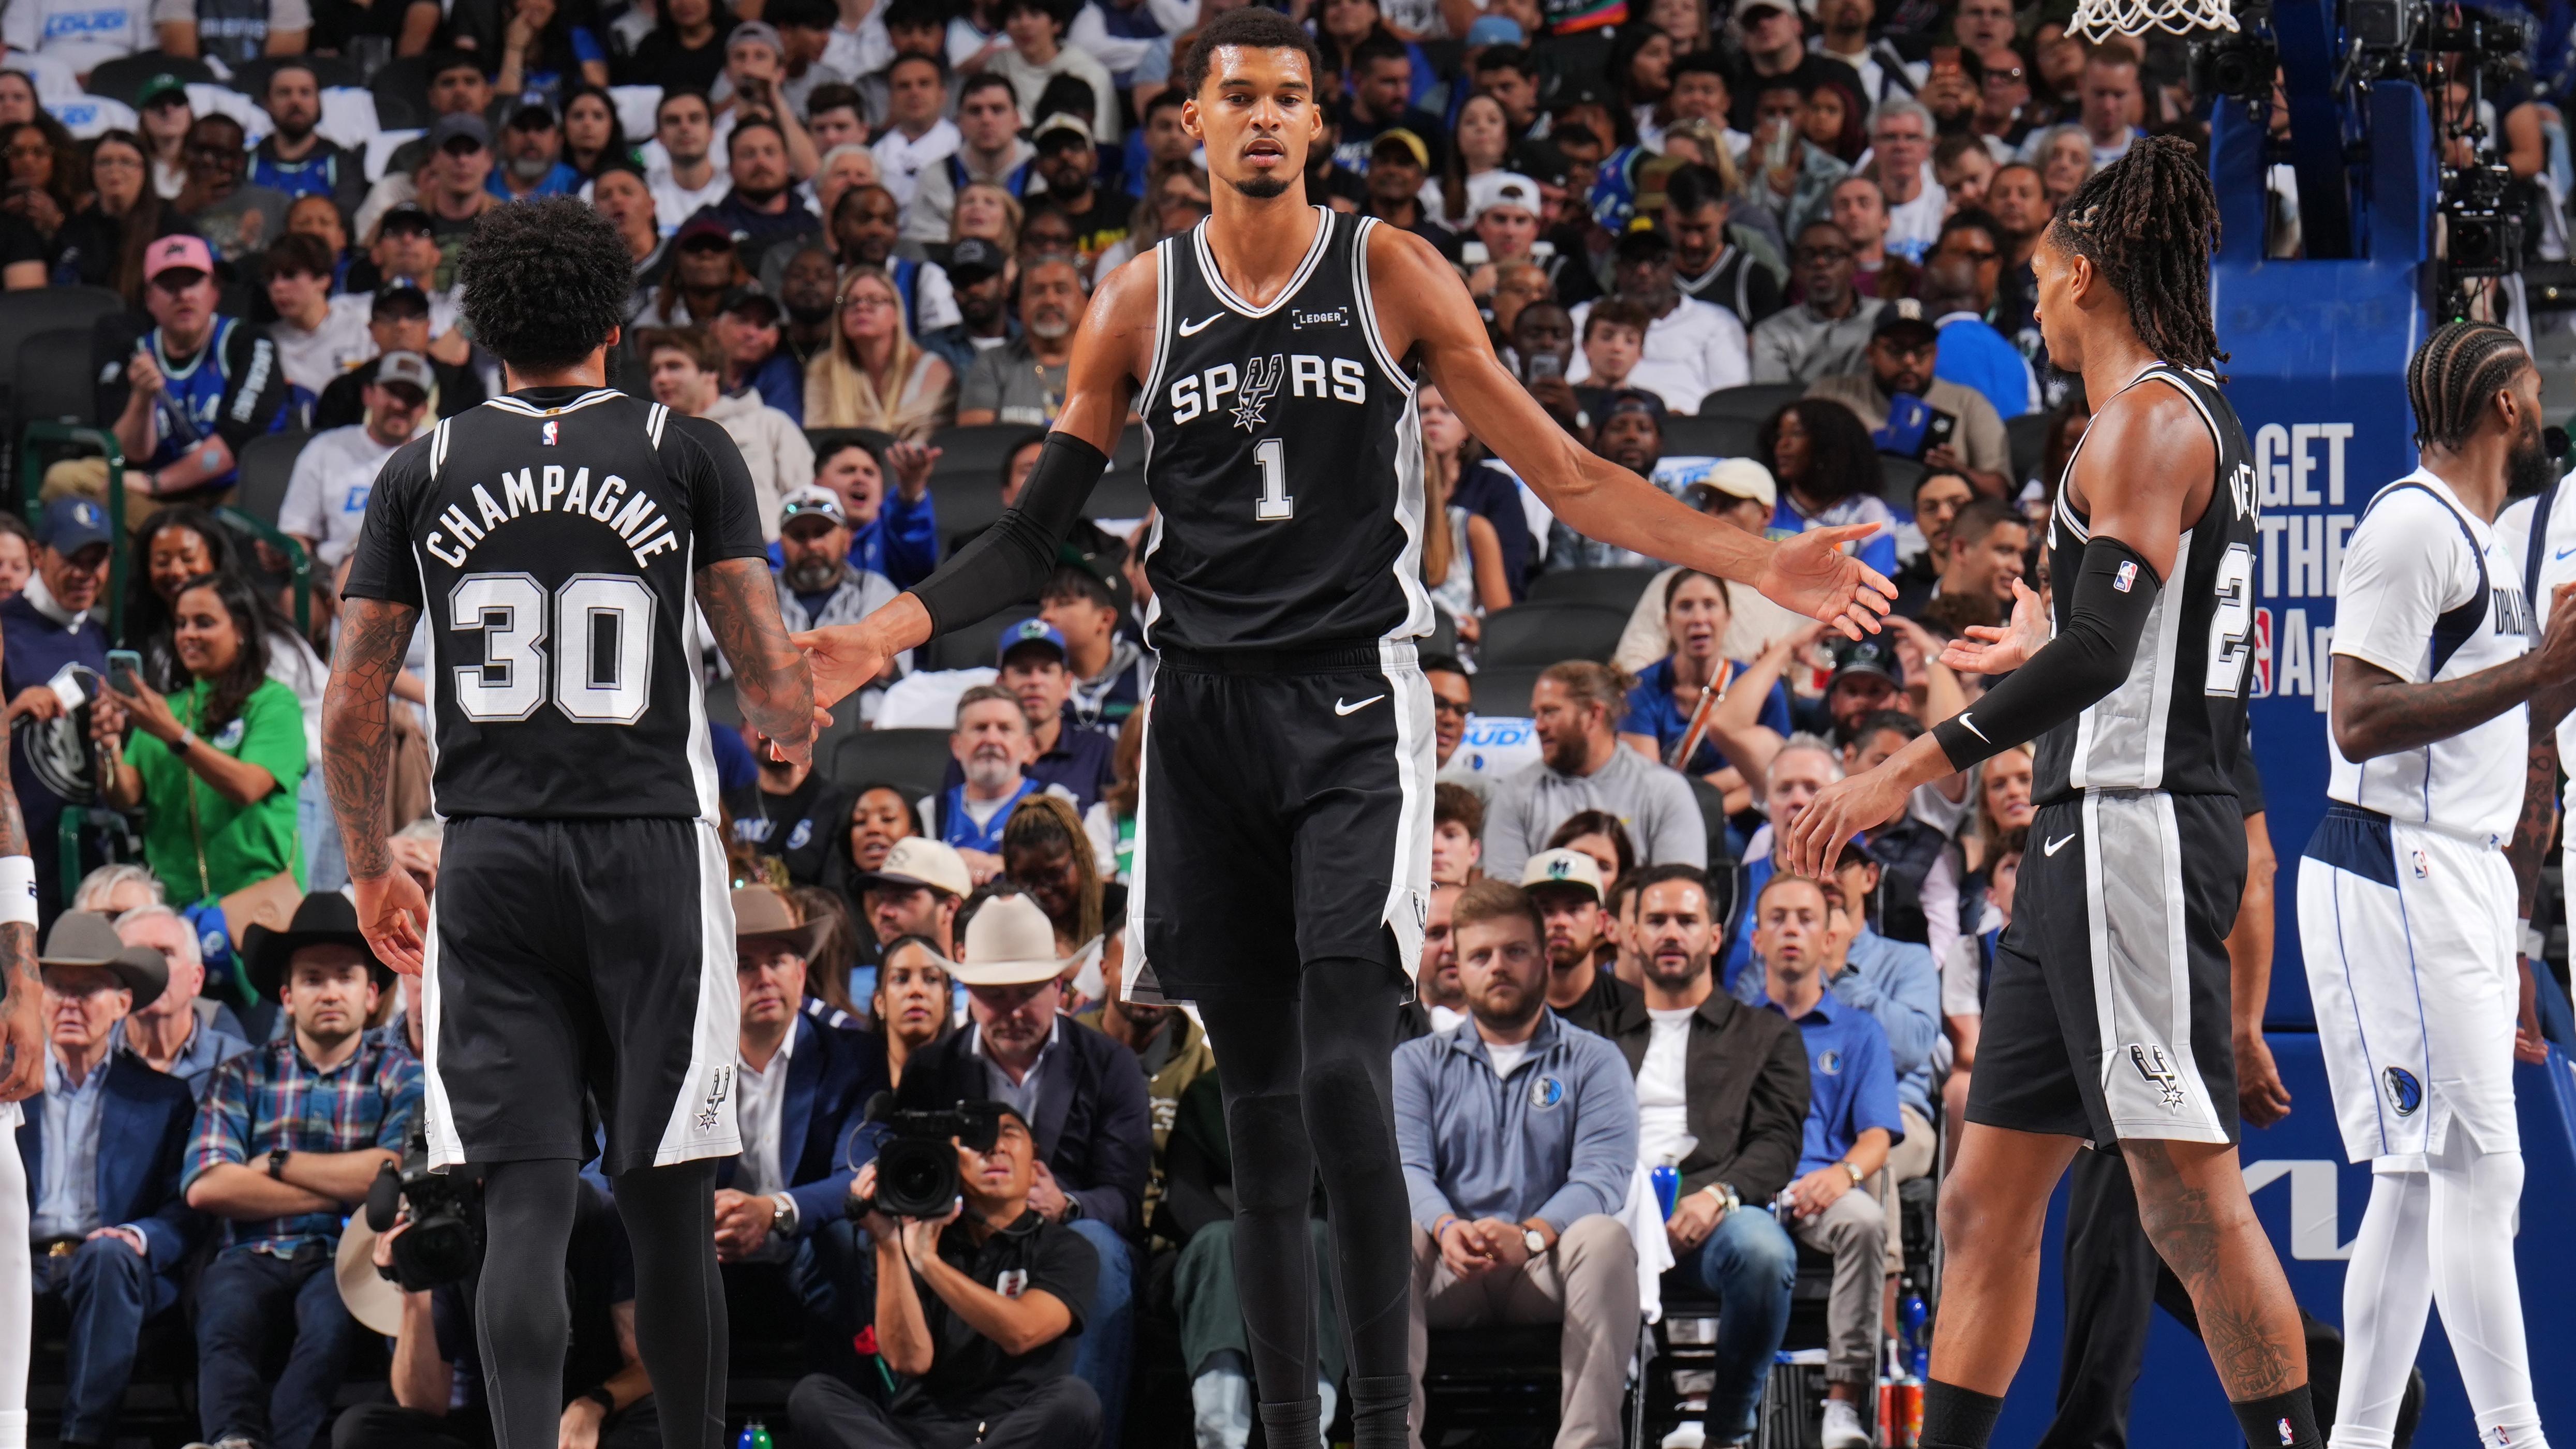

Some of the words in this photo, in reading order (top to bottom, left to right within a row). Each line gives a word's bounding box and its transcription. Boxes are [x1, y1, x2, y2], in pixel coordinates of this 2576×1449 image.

[1299, 312, 1341, 324] LEDGER
[1170, 353, 1366, 434] SPURS
[1253, 438, 1293, 521] 1
[2255, 423, 2354, 507] GET
[426, 465, 678, 568] CHAMPAGNIE
[2258, 514, 2355, 598] THE
[448, 572, 658, 725] 30
[2204, 542, 2256, 699] 2
